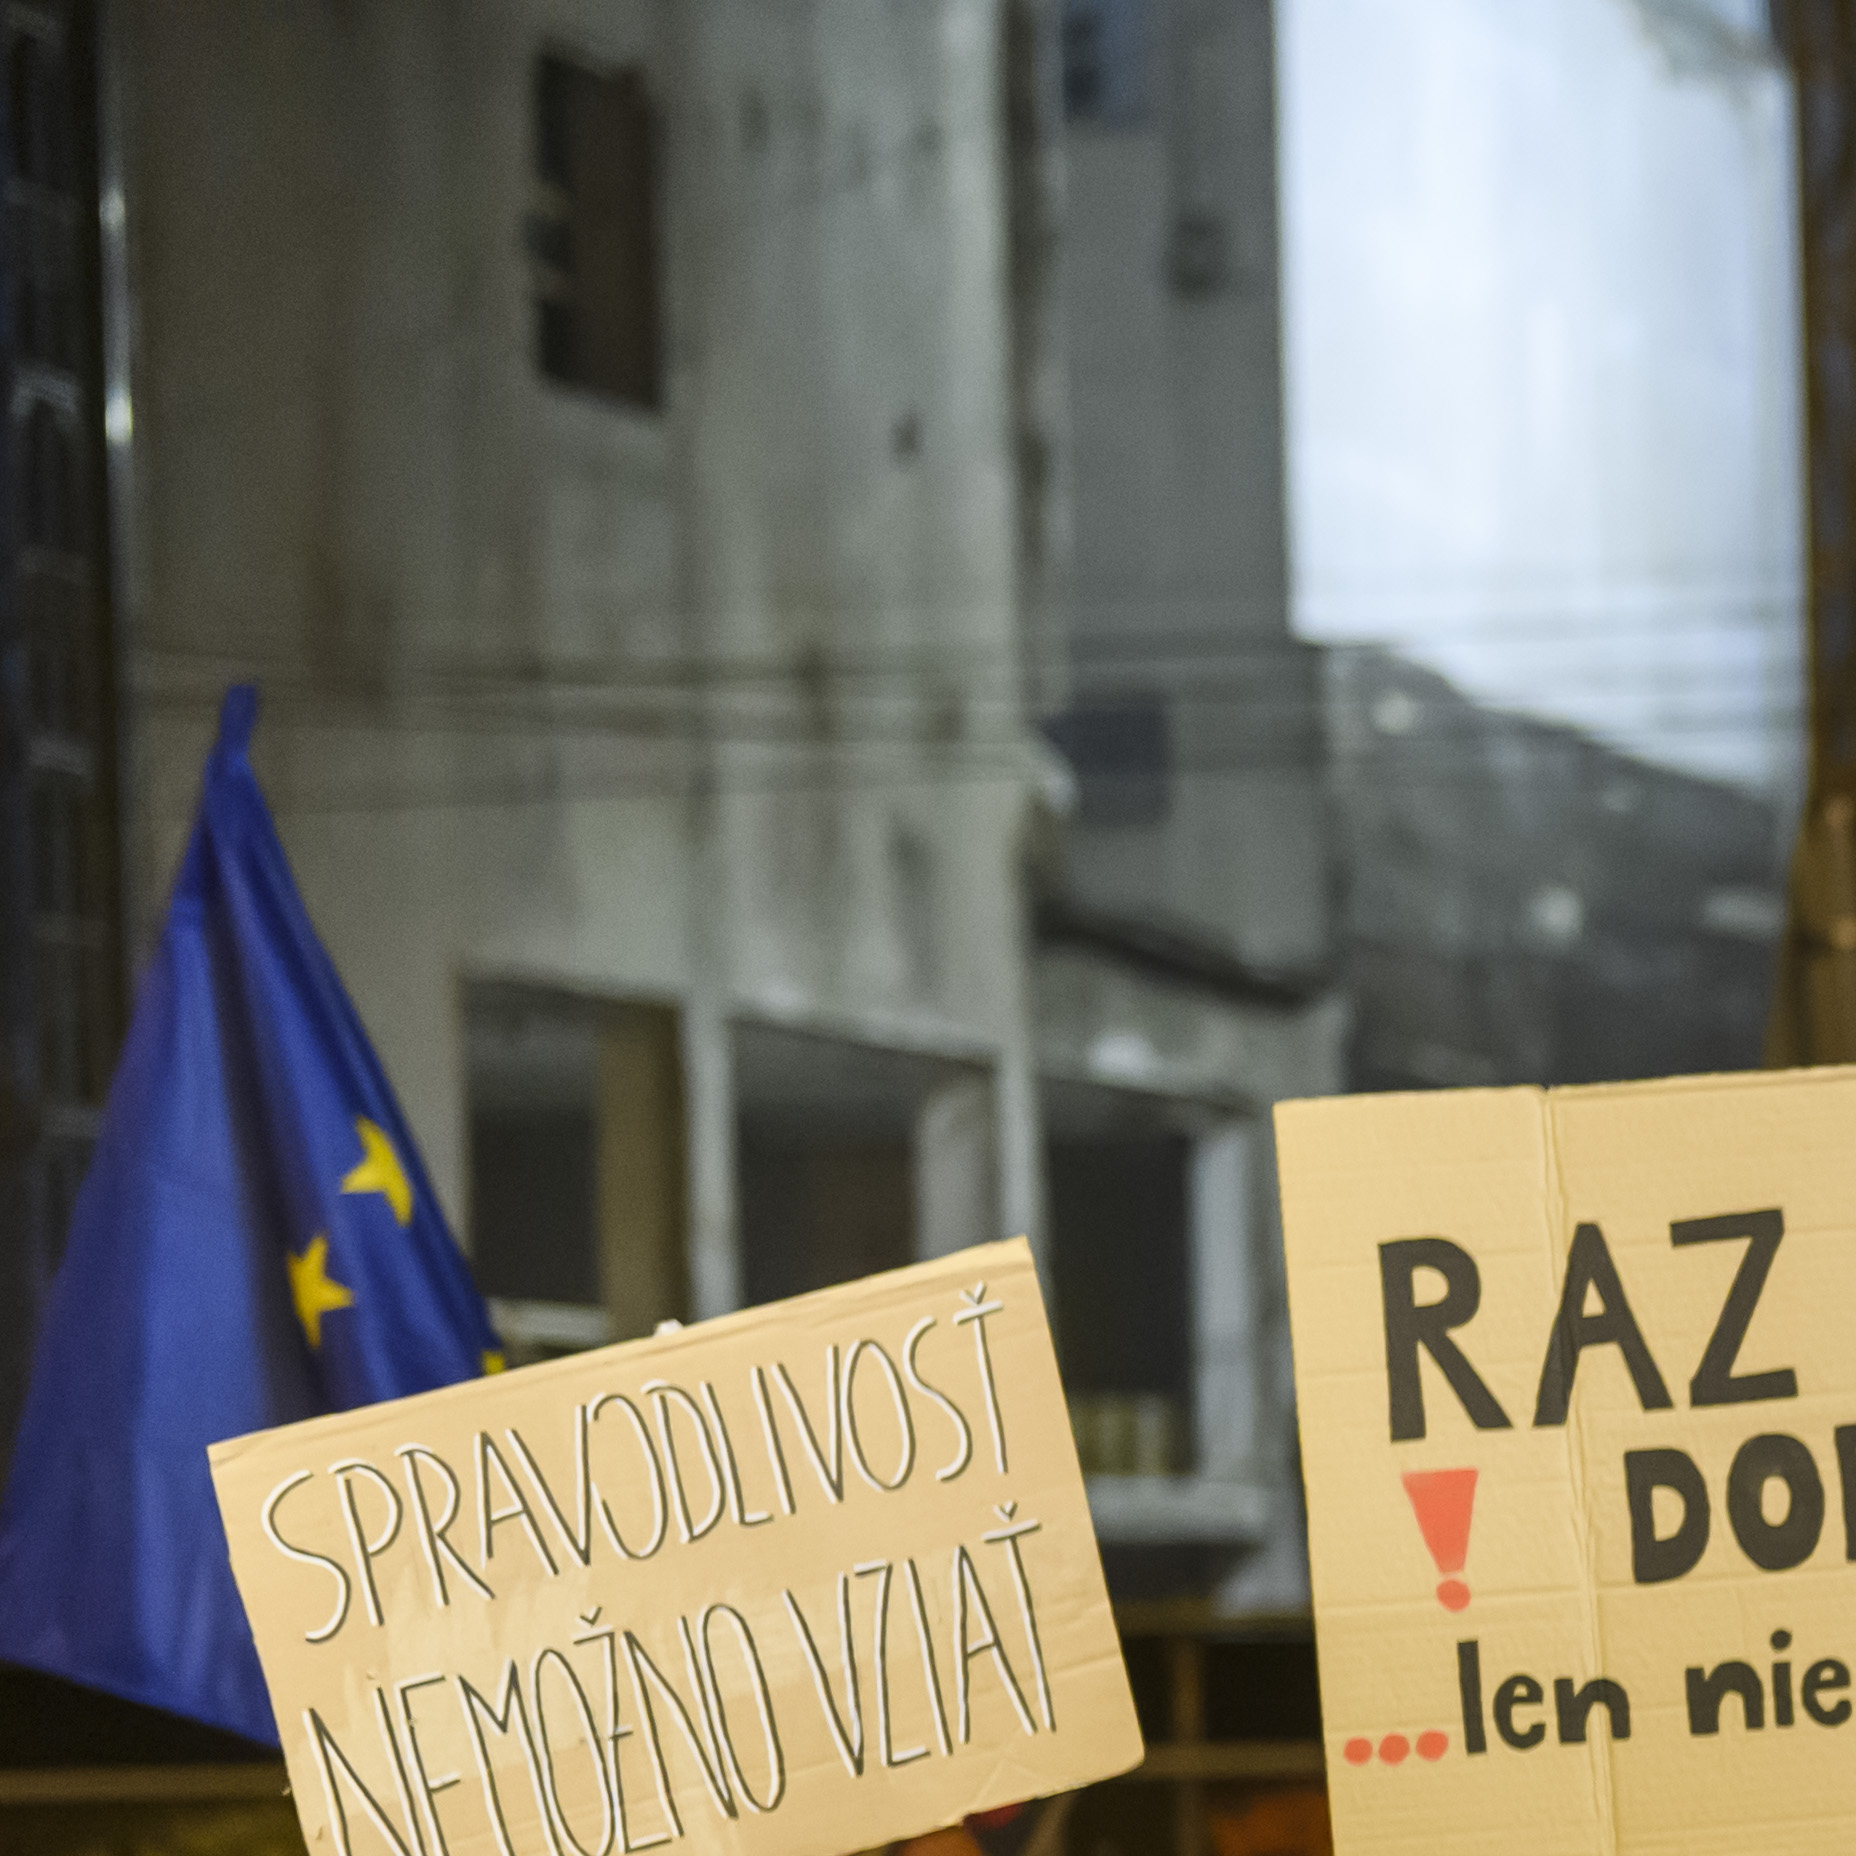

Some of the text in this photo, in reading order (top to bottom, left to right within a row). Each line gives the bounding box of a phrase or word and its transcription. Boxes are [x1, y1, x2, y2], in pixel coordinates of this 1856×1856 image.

[1376, 1206, 1800, 1443] RAZ
[260, 1281, 1004, 1645] SPRAVODLIVOSŤ
[781, 1500, 1055, 1777] VZIAŤ
[1686, 1628, 1853, 1737] nie
